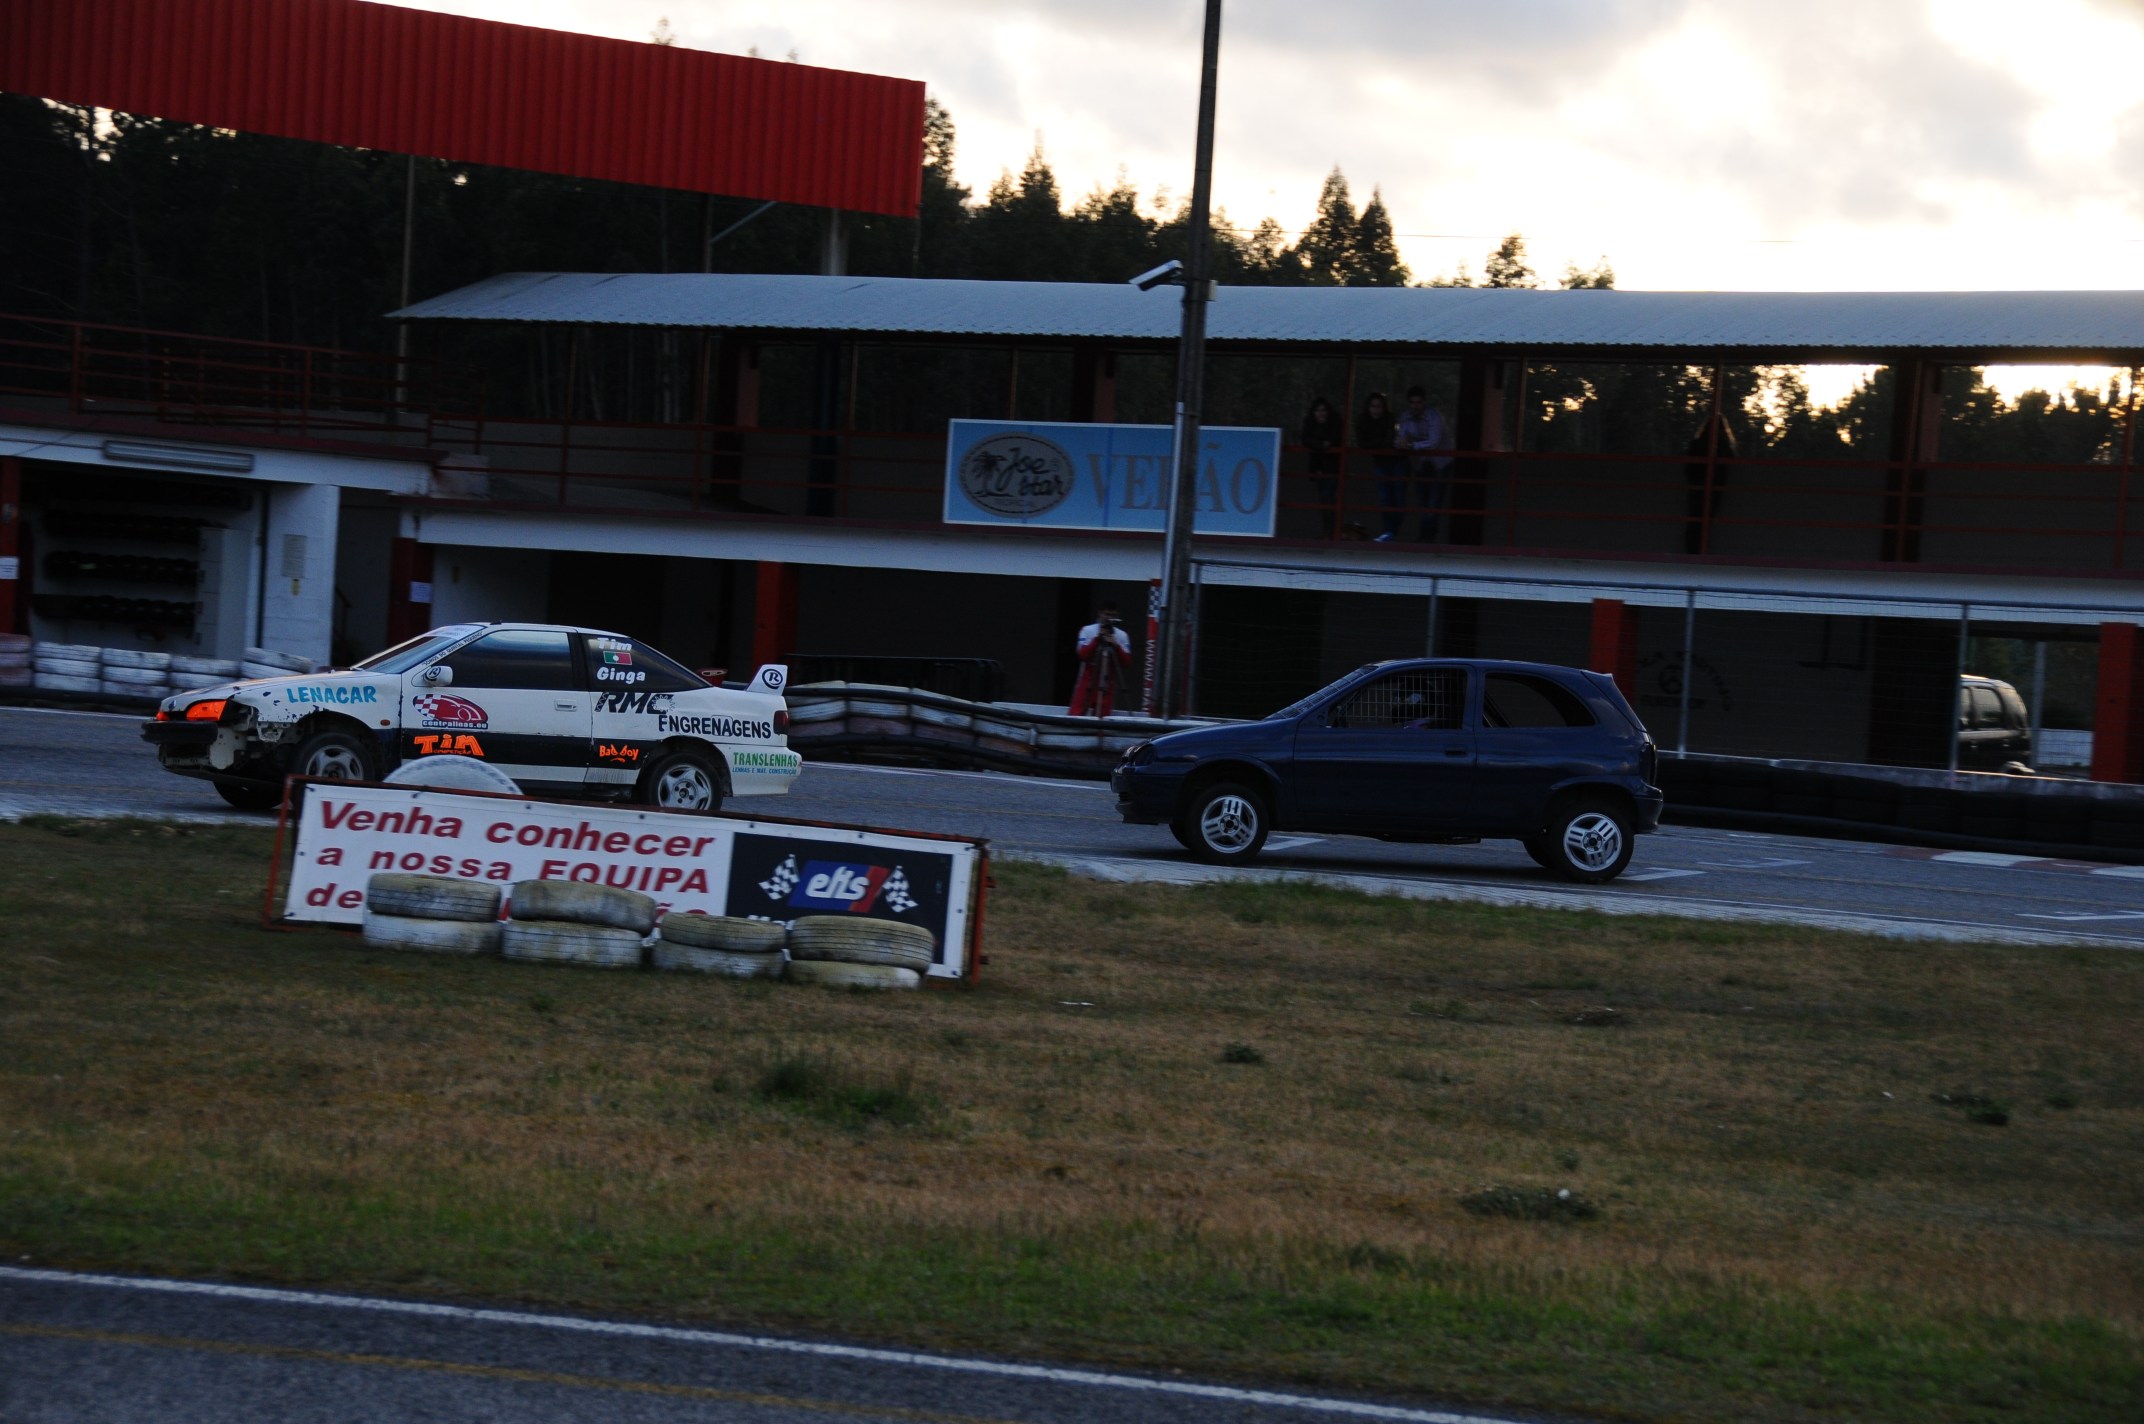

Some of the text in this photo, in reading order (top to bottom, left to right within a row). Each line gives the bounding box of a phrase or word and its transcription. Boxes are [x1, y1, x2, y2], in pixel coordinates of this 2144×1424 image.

[597, 638, 632, 651] Tim
[597, 666, 645, 684] Ginga
[286, 685, 376, 704] LENACAR
[659, 715, 771, 738] ENGRENAGENS
[733, 752, 798, 767] TRANSLENHAS
[322, 801, 716, 857] Venha conhecer
[317, 847, 709, 893] a nossa EQUIPA
[307, 883, 363, 909] de
